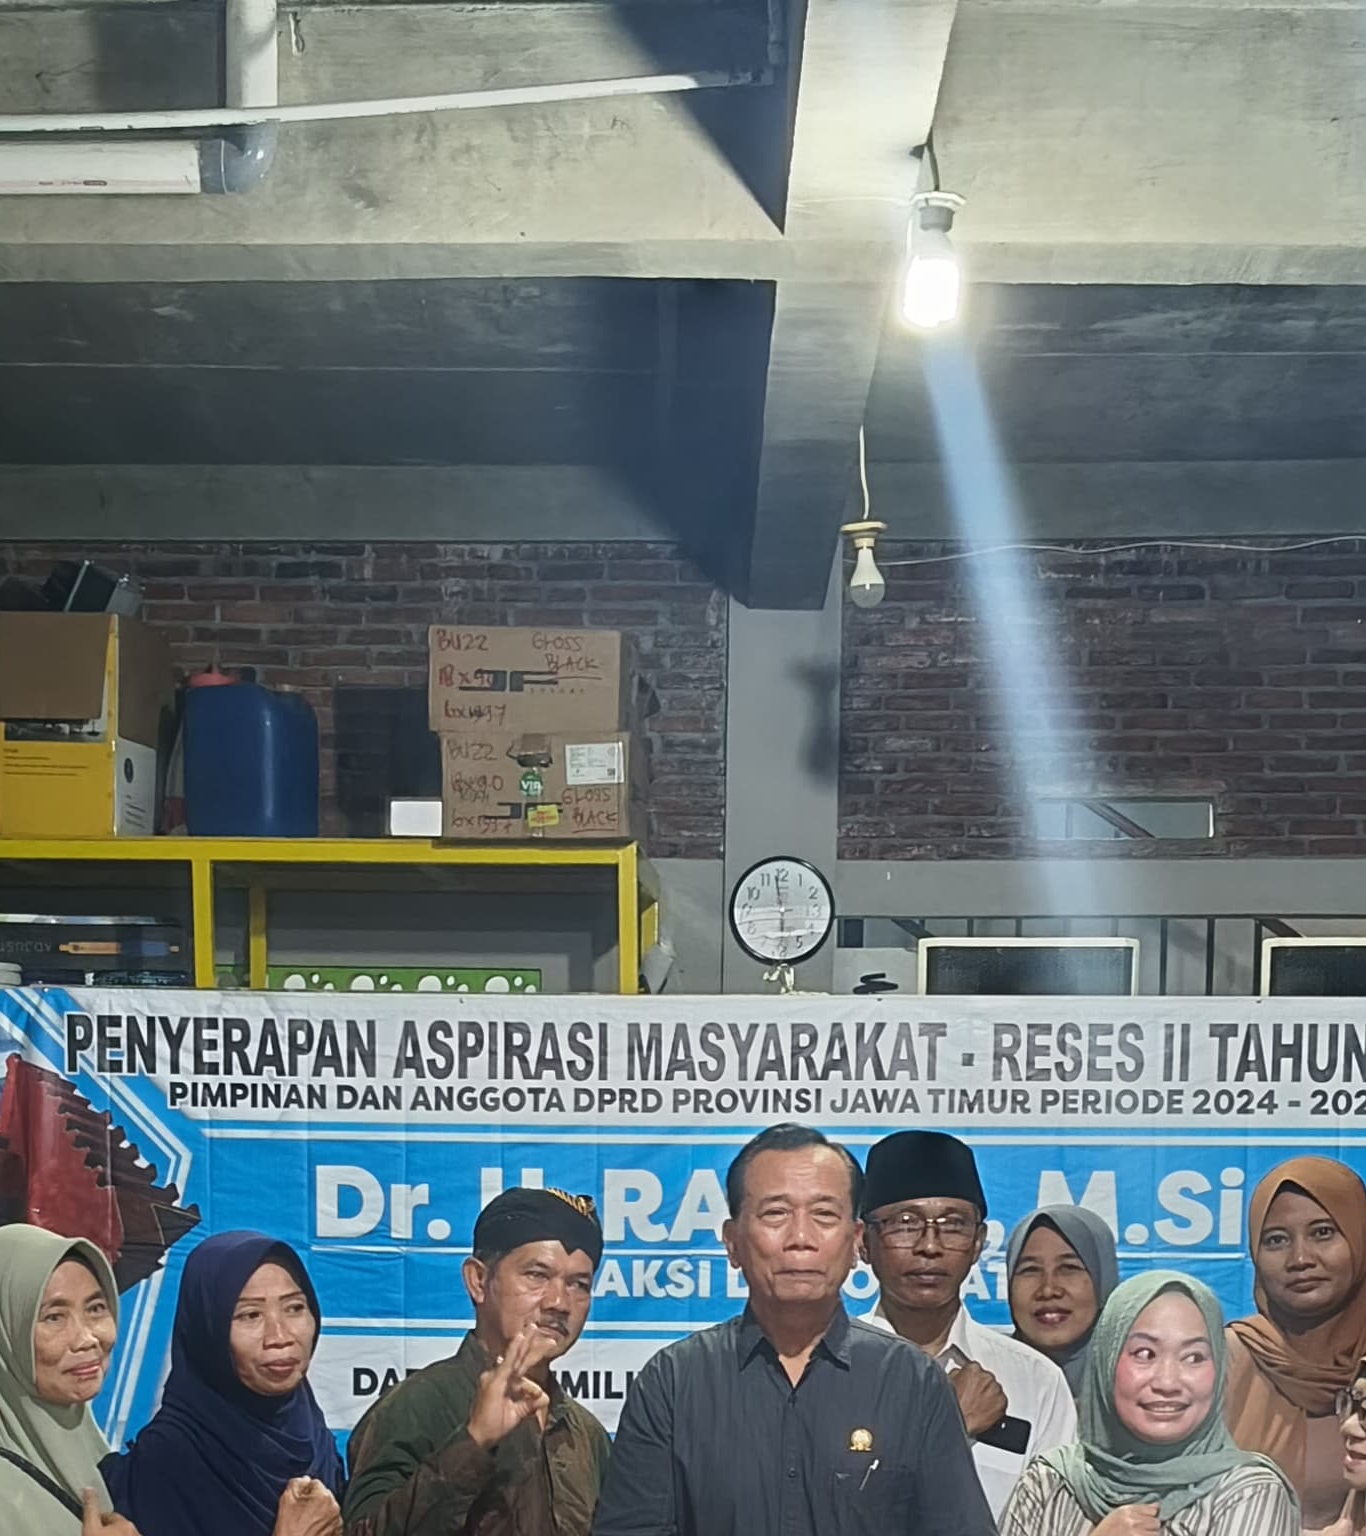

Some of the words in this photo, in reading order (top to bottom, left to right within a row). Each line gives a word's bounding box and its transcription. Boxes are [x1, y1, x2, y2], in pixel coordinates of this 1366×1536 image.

[65, 1013, 377, 1078] PENYERAPAN
[392, 1019, 609, 1081] ASPIRASI
[626, 1021, 948, 1082] MASYARAKAT
[991, 1022, 1145, 1082] RESES
[1162, 1023, 1191, 1082] II
[169, 1081, 327, 1109] PIMPINAN
[336, 1083, 403, 1111] DAN
[409, 1085, 567, 1113] ANGGOTA
[573, 1087, 663, 1114] DPRD
[671, 1087, 822, 1114] PROVINSI
[829, 1087, 921, 1114] JAWA
[926, 1088, 1032, 1115] TIMUR
[1040, 1088, 1184, 1115] PERIODE
[1192, 1088, 1279, 1115] 2024
[315, 1164, 452, 1241] Dr.
[1037, 1167, 1245, 1247] M.Si
[590, 1259, 712, 1298] AKSI
